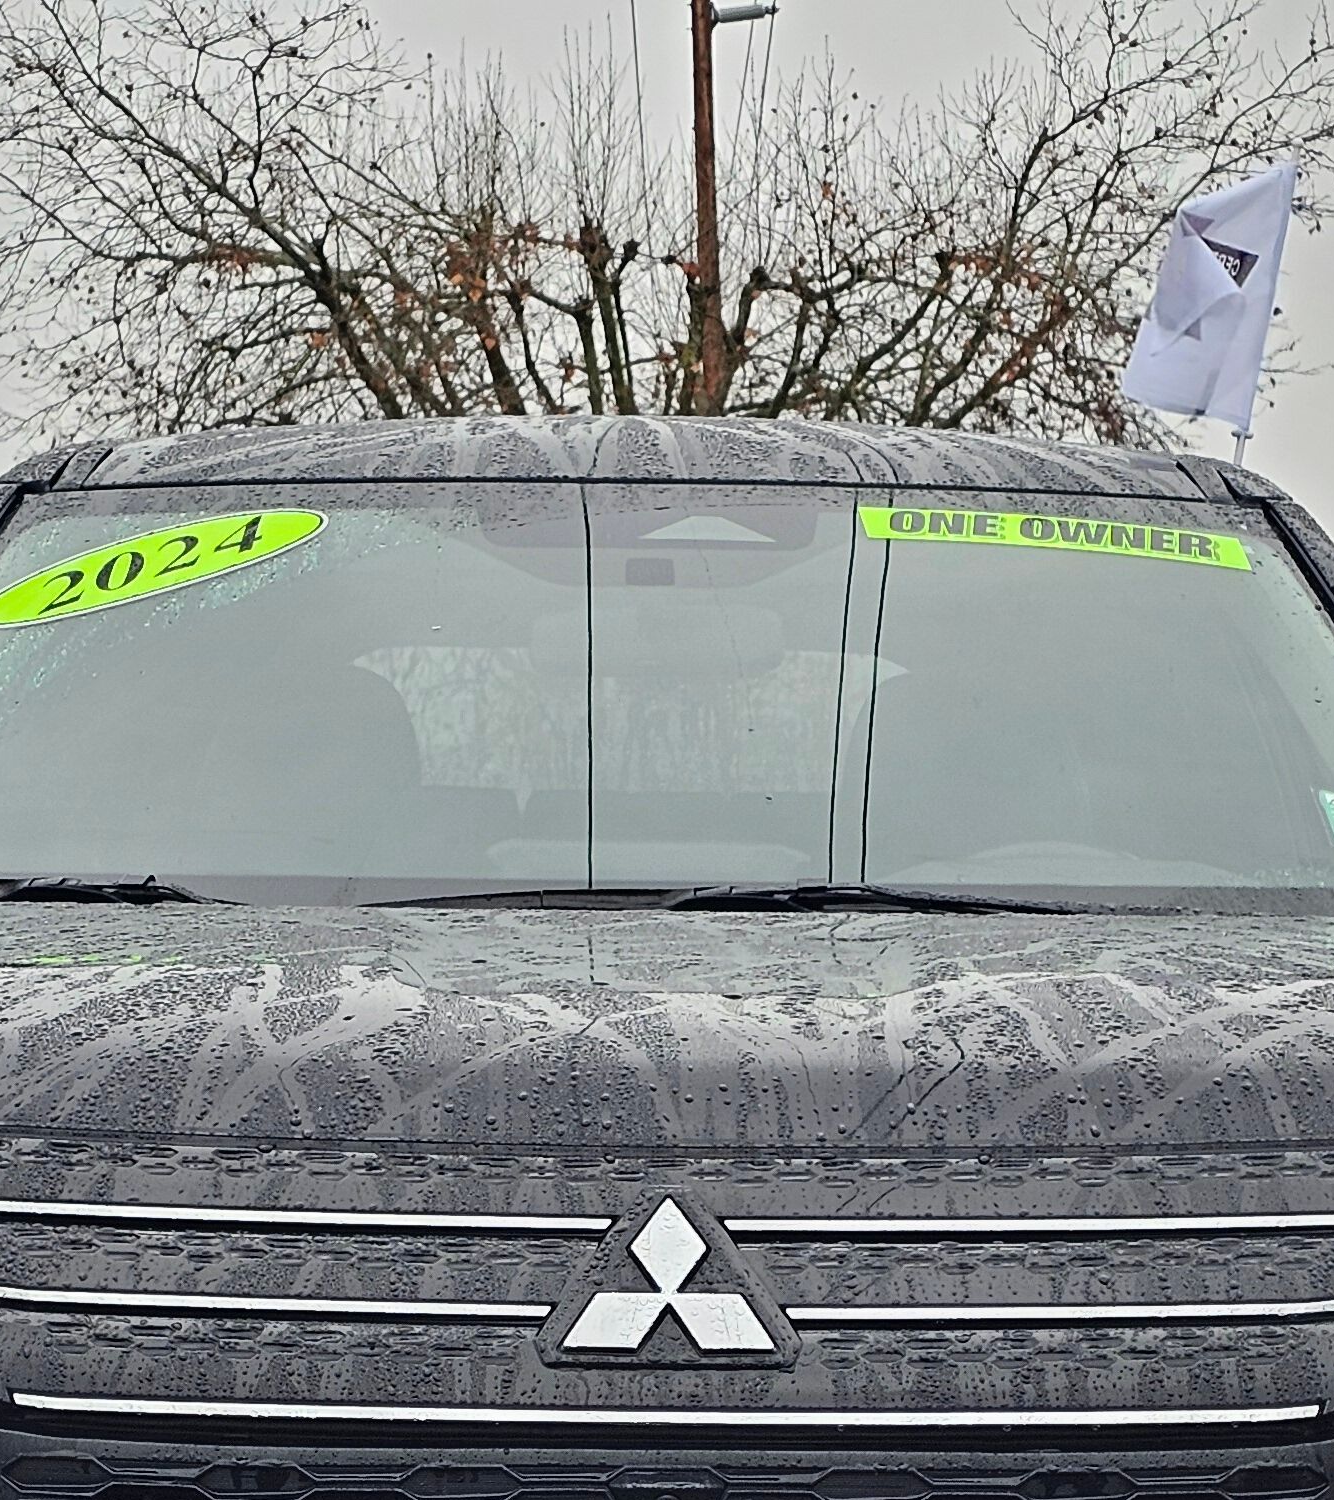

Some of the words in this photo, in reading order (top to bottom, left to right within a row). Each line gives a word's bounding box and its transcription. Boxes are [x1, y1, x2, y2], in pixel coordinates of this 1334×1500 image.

[37, 514, 264, 616] 2024
[889, 510, 1006, 540] ONE
[1019, 517, 1219, 561] OWNER
